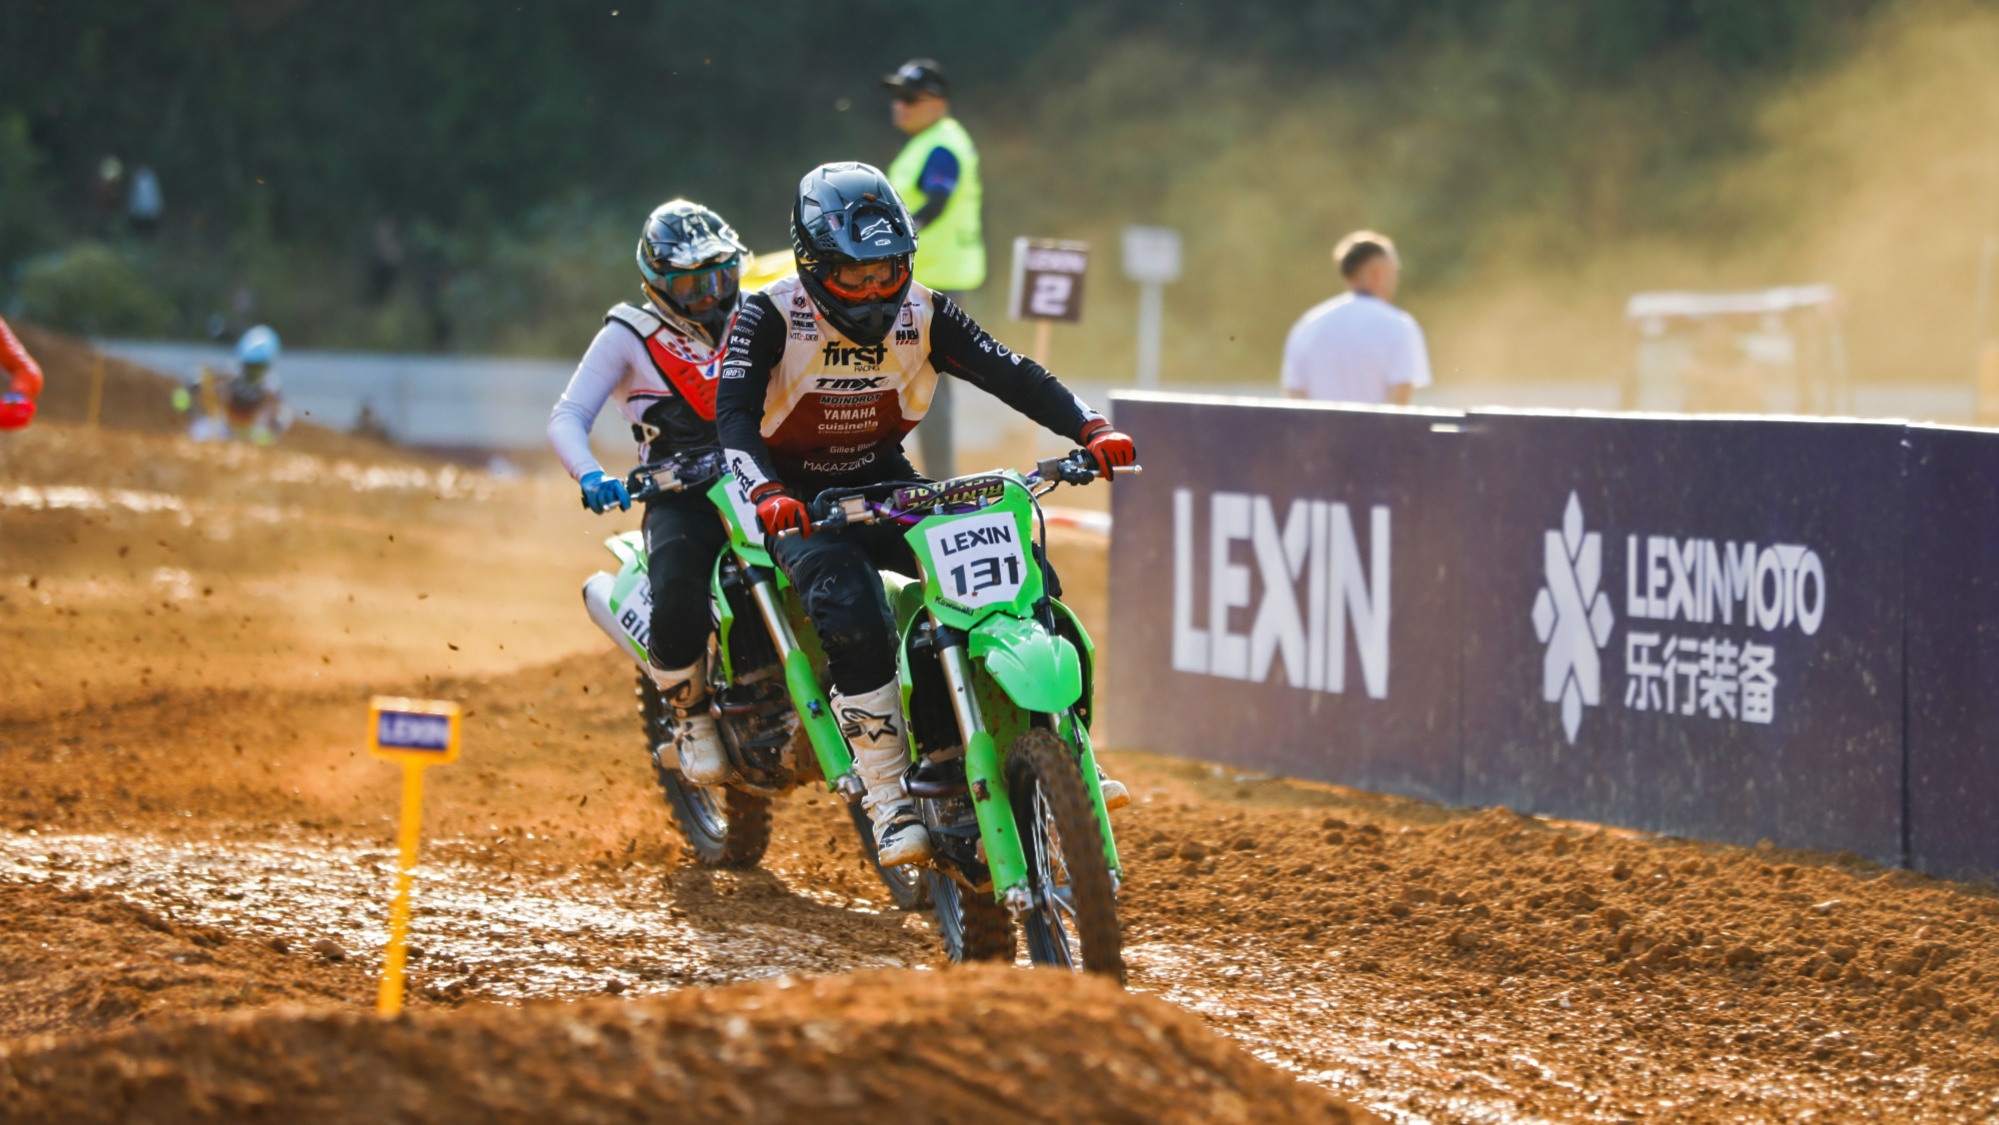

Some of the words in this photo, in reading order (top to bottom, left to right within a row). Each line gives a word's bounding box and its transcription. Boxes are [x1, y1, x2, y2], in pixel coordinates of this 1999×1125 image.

[1030, 274, 1073, 316] 2
[822, 341, 888, 366] first
[722, 367, 746, 379] 100%
[854, 363, 880, 372] RACING
[819, 393, 884, 406] MOINDROT
[823, 406, 877, 421] YAMAHA
[830, 446, 856, 454] Gilles
[940, 525, 1012, 556] LEXIN
[951, 556, 1019, 597] 131
[1626, 534, 1826, 636] LEXINMOTO
[1173, 487, 1391, 700] LEXIN
[934, 596, 974, 617] Kawasaki
[1623, 631, 1778, 725] 乐行装备
